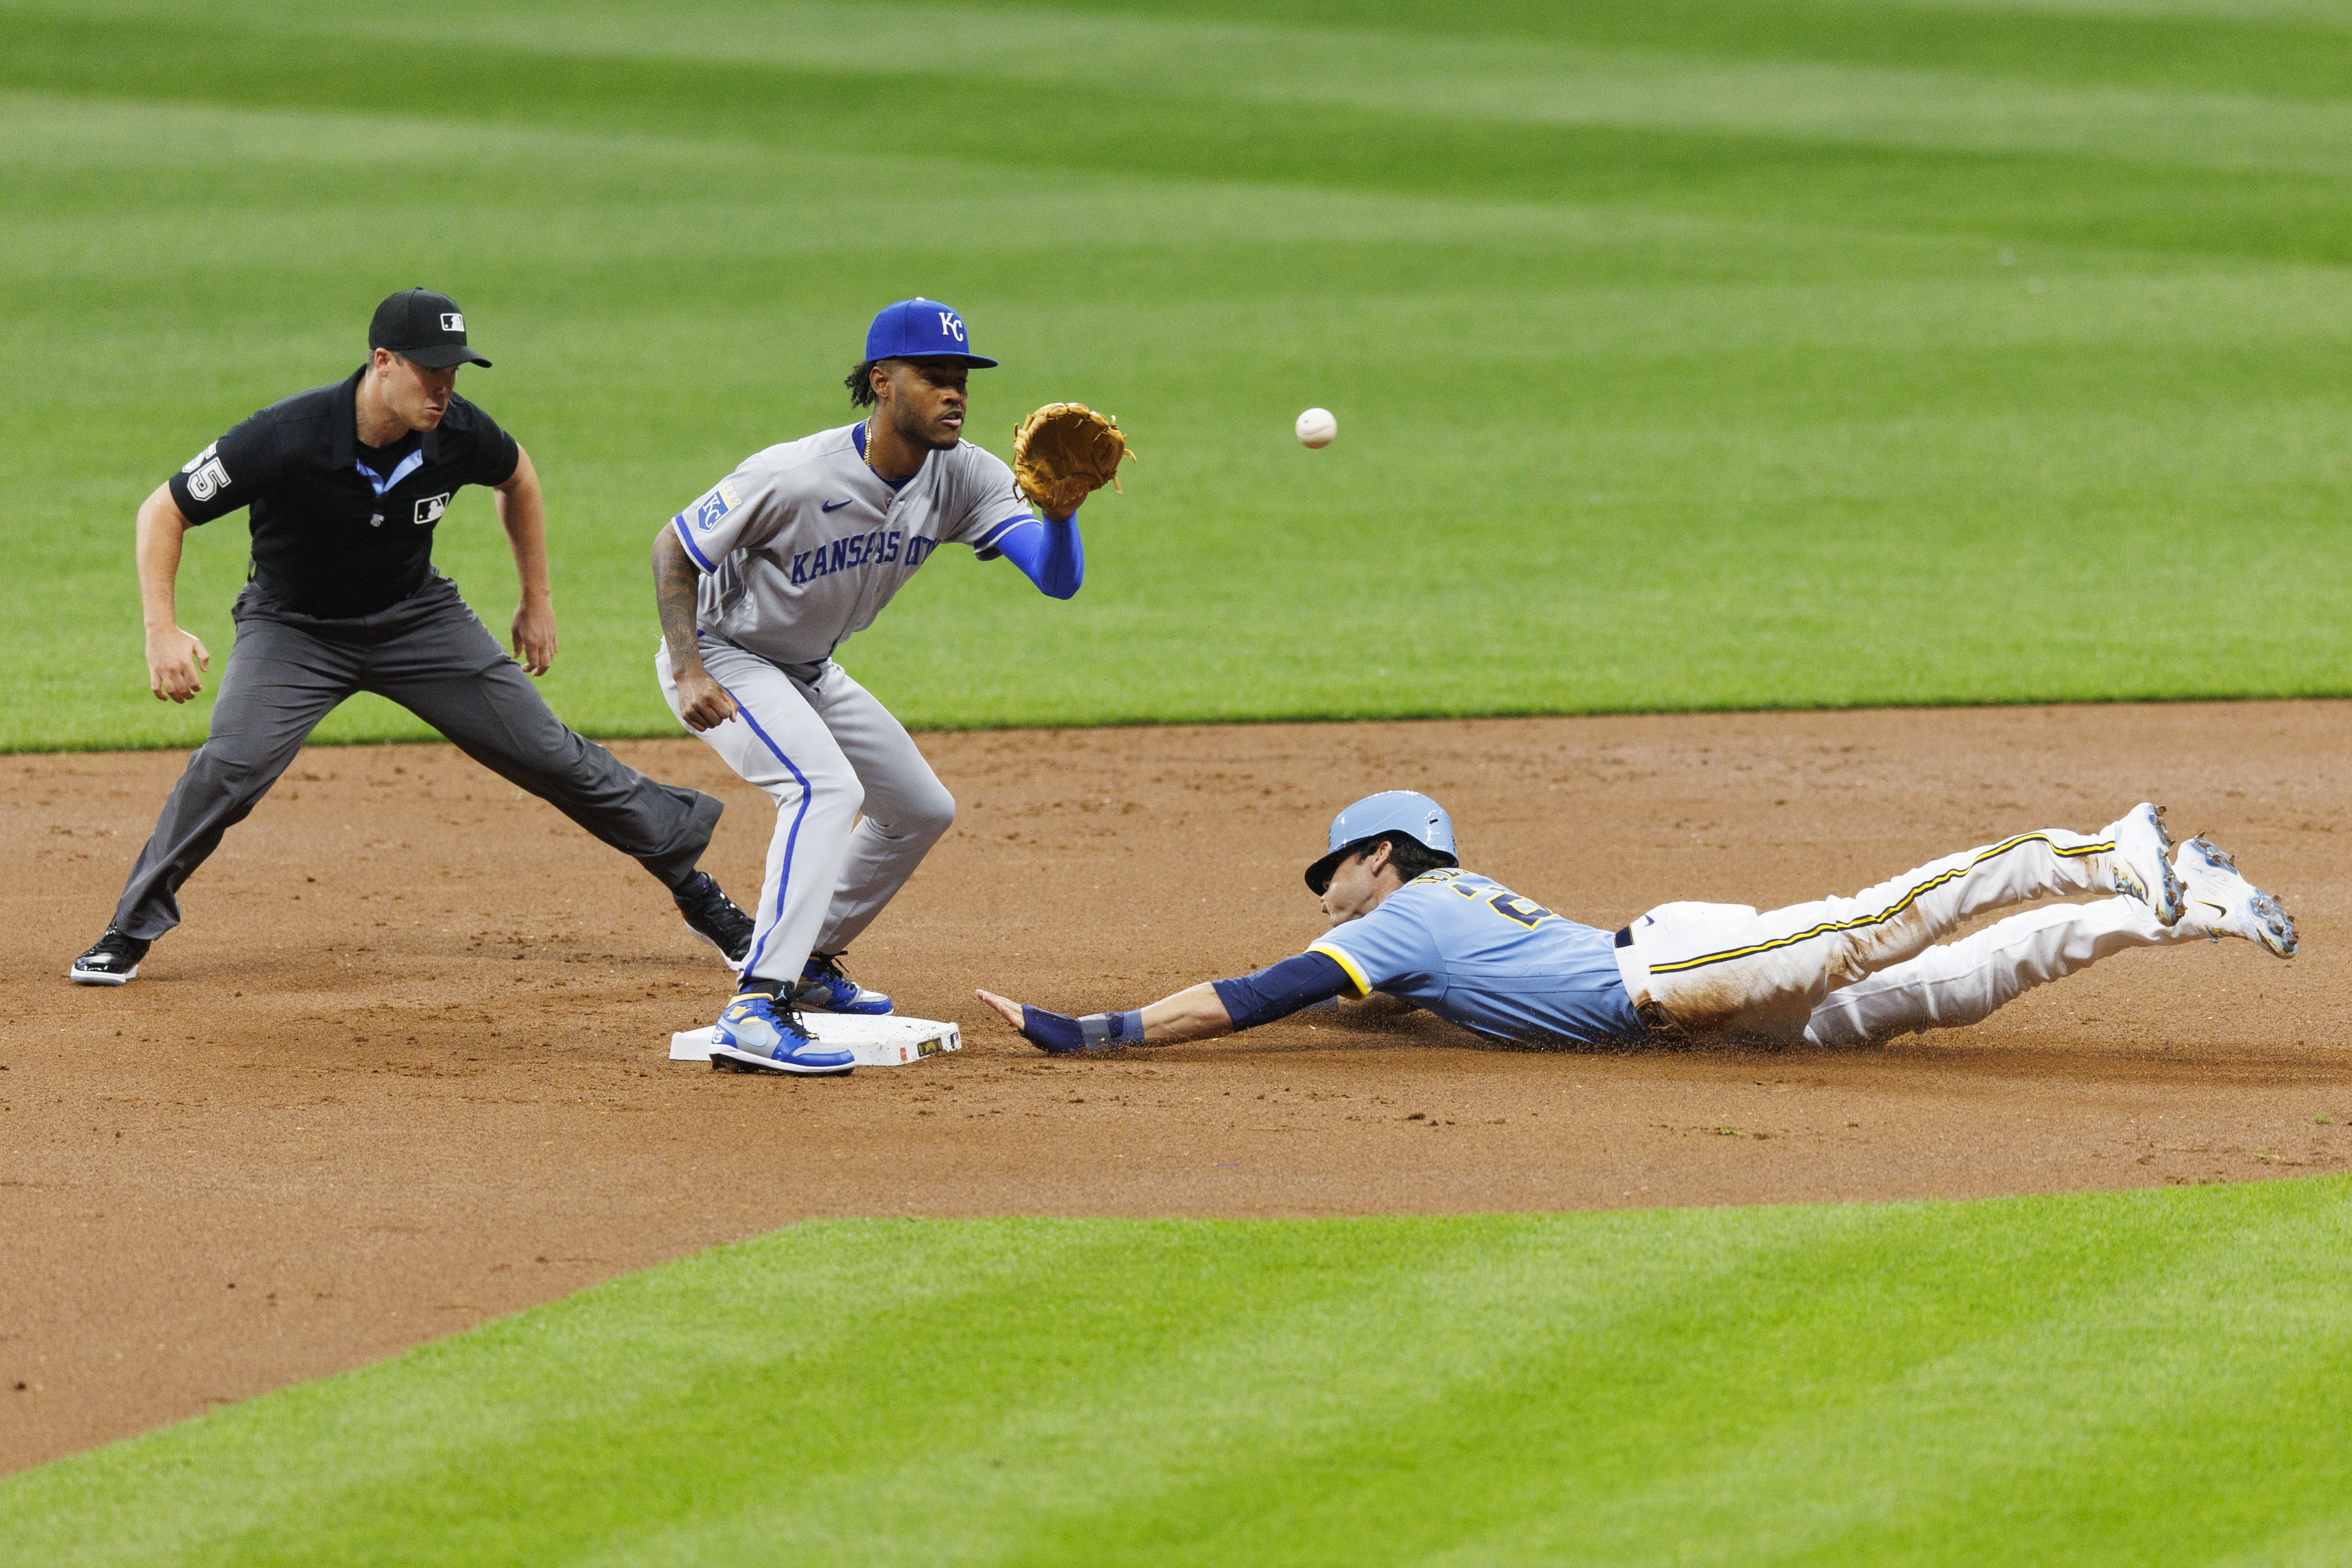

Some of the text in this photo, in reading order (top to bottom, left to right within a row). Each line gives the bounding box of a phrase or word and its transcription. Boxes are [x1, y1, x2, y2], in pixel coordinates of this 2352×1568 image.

[938, 312, 964, 342] KC
[702, 494, 721, 528] KC
[791, 531, 901, 584] KANSAS
